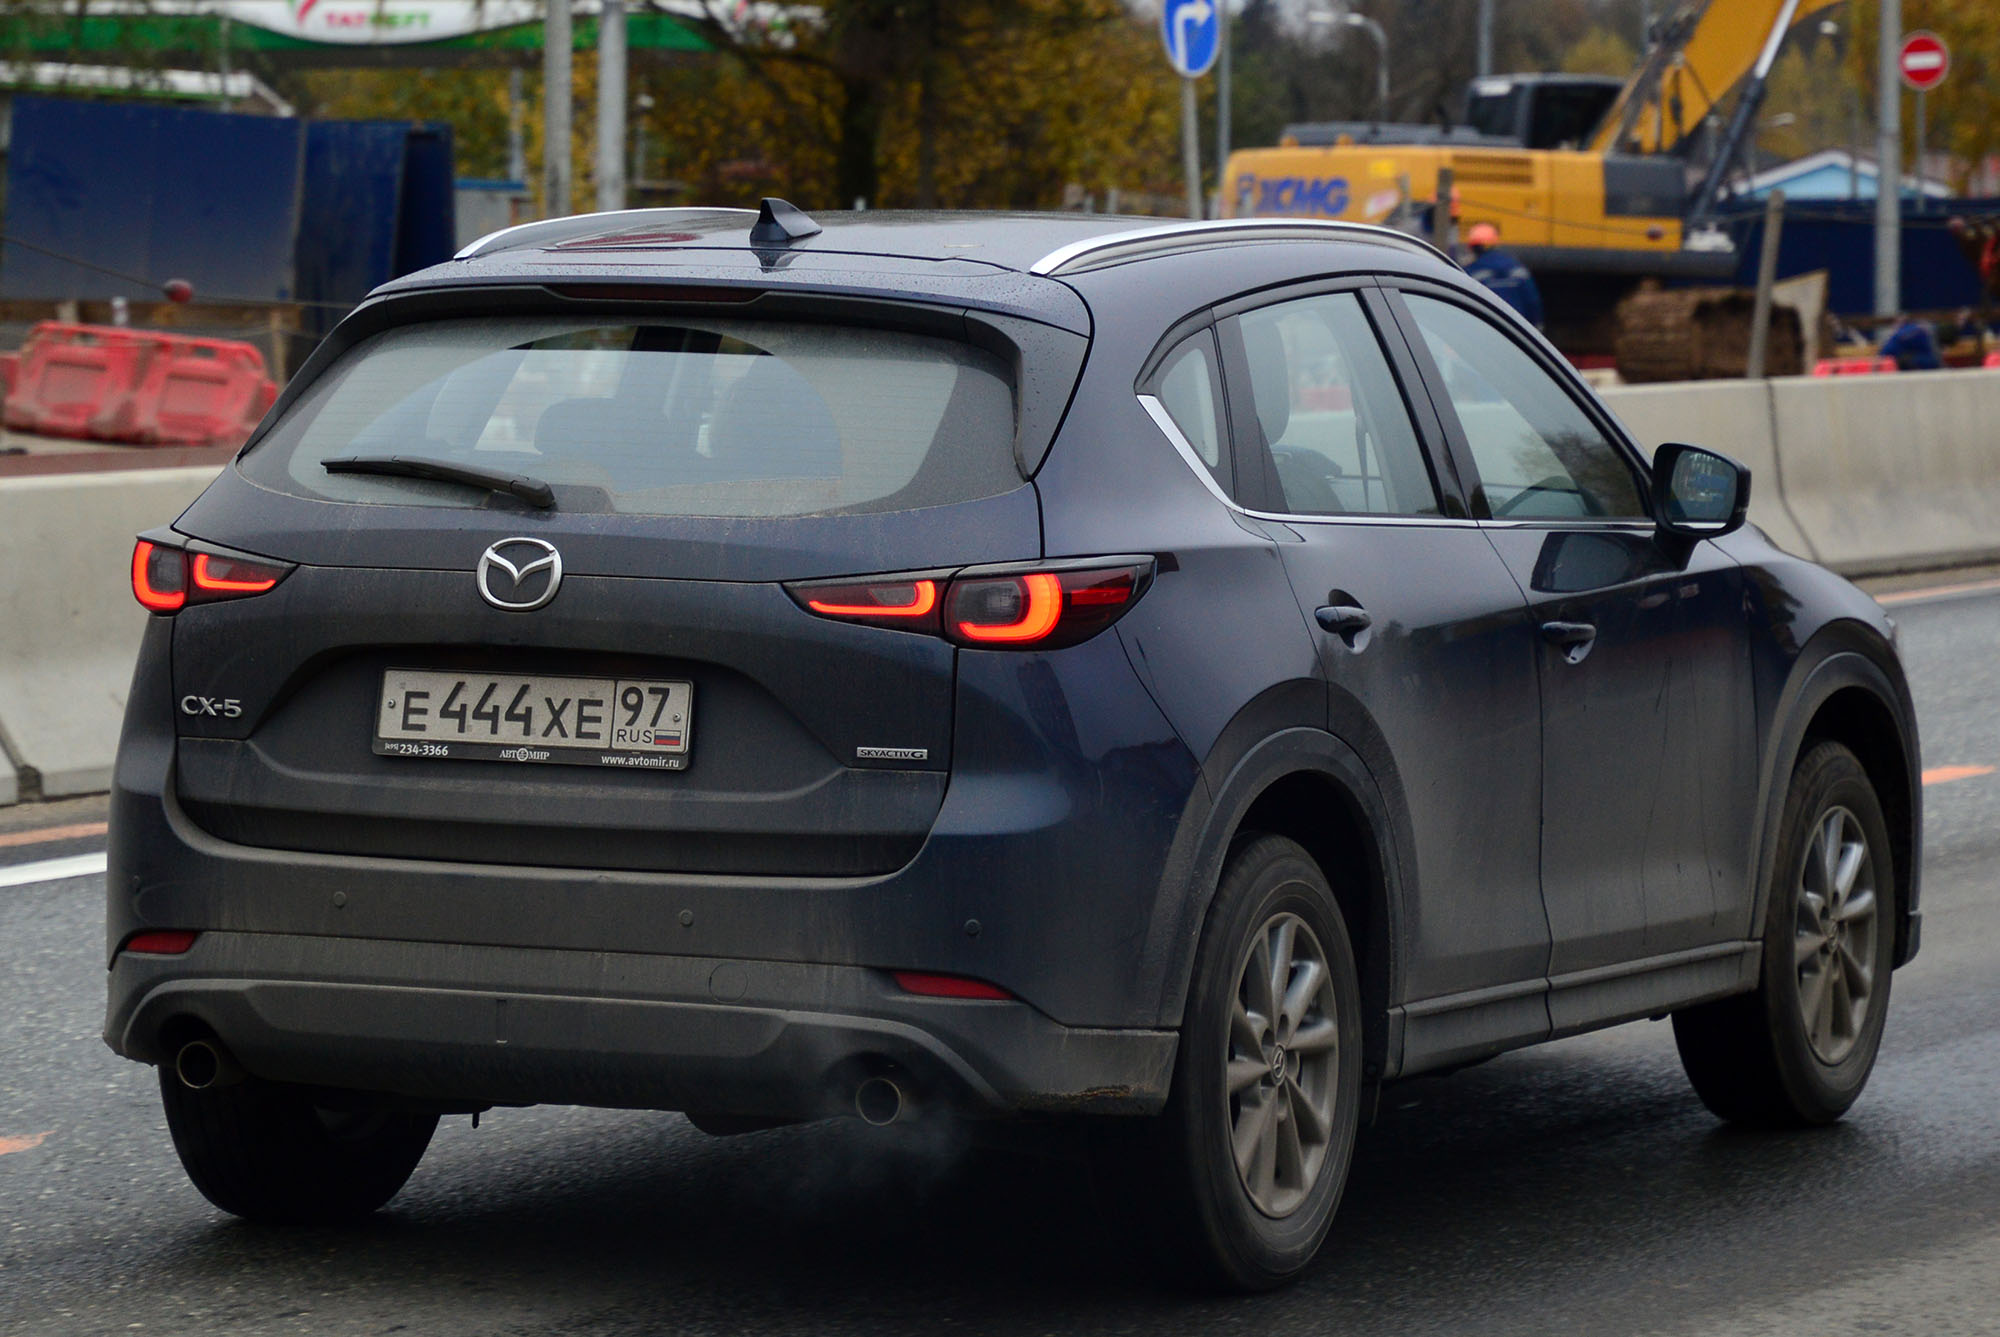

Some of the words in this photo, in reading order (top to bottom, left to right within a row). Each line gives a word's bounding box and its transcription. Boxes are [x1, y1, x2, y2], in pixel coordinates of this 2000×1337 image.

[1256, 177, 1348, 216] XCMG
[181, 695, 242, 718] CX-5
[621, 686, 670, 728] 97
[616, 729, 652, 744] RUS
[399, 743, 449, 756] 234-3366
[601, 754, 680, 768] www.avtomir.ru
